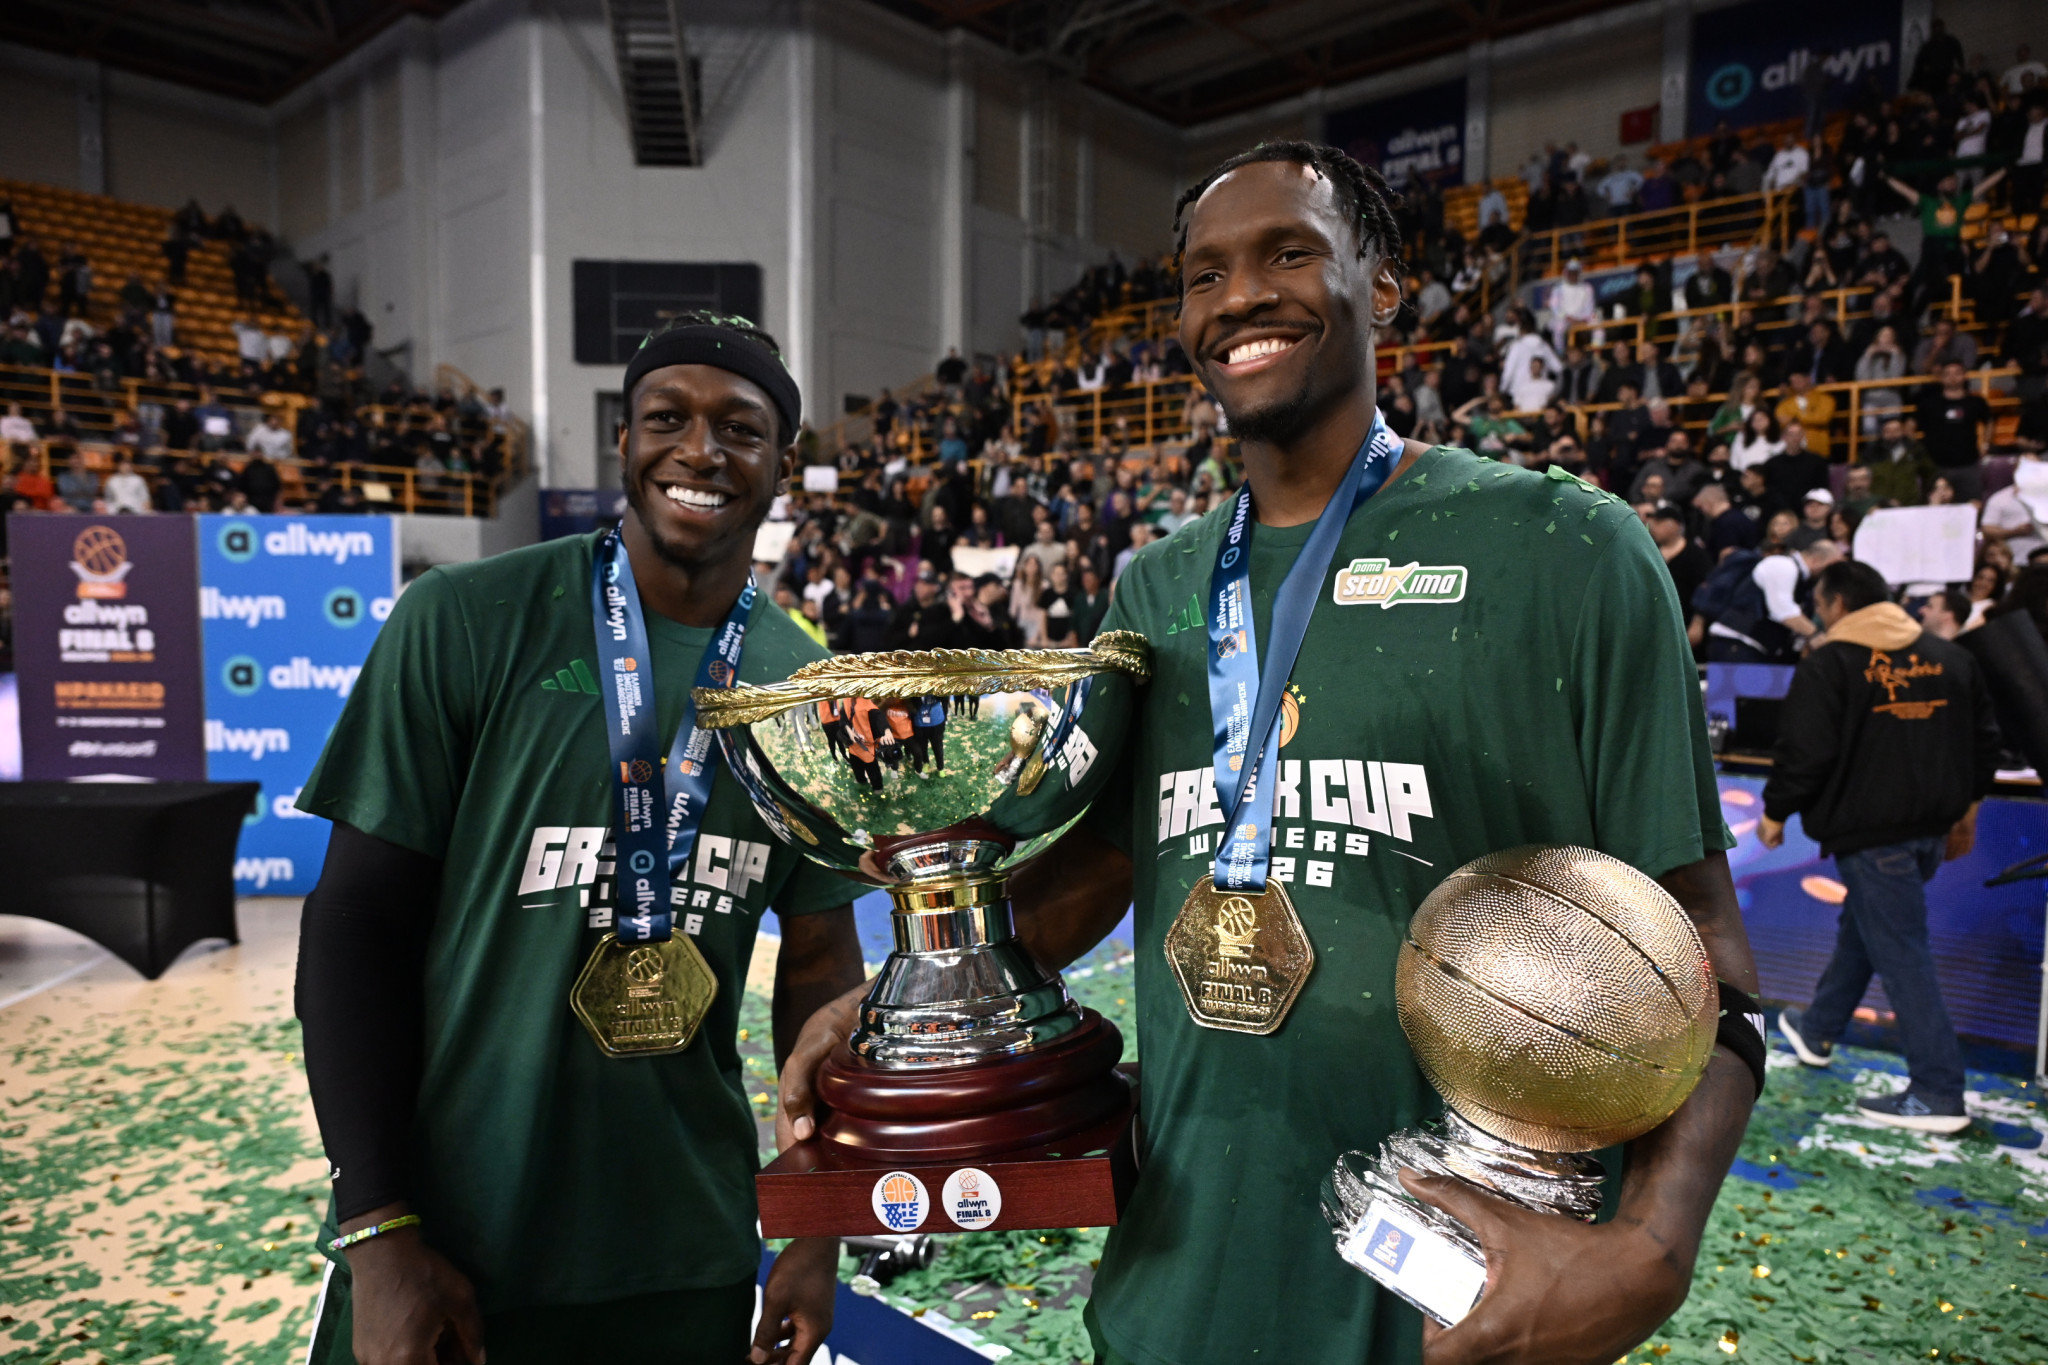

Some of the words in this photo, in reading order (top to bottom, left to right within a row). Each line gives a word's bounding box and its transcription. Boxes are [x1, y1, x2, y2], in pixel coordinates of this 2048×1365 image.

[1228, 493, 1249, 545] allwyn
[265, 523, 375, 565] allwyn
[1353, 563, 1383, 573] pame
[1227, 581, 1236, 591] 8
[64, 599, 148, 632] allwyn
[200, 587, 286, 629] llwyn
[606, 586, 627, 640] allwyn
[1216, 589, 1226, 630] allwyn
[1229, 591, 1239, 629] FINAL
[718, 621, 736, 656] allwyn
[727, 632, 743, 664] FINAL
[205, 719, 290, 761] llwyn
[1227, 716, 1236, 754] ΕΛΛΗΝΙΚΗ
[1234, 704, 1242, 752] ΟΜΟΣΠΟΝΔΙΑ
[629, 787, 640, 823] FINAL
[641, 789, 653, 828] allwyn
[1158, 759, 1301, 845] GREK
[1309, 759, 1434, 843] CUP
[631, 824, 641, 832] 8
[233, 857, 294, 890] wyn
[694, 833, 771, 899] CUP
[1209, 856, 1334, 887] 26
[1243, 843, 1256, 882] ΕΛΛΗΝΙΚΗ
[632, 878, 655, 940] allwyn
[1207, 957, 1268, 980] allwyn
[617, 999, 676, 1019] allwyn
[1200, 981, 1255, 1004] FINAL
[1258, 988, 1271, 1005] 8
[612, 1018, 667, 1035] FINAL
[884, 1173, 907, 1183] BASKETBALL
[907, 1177, 918, 1202] FEDERATION
[957, 1198, 988, 1209] allwyn
[956, 1210, 983, 1218] FINAL
